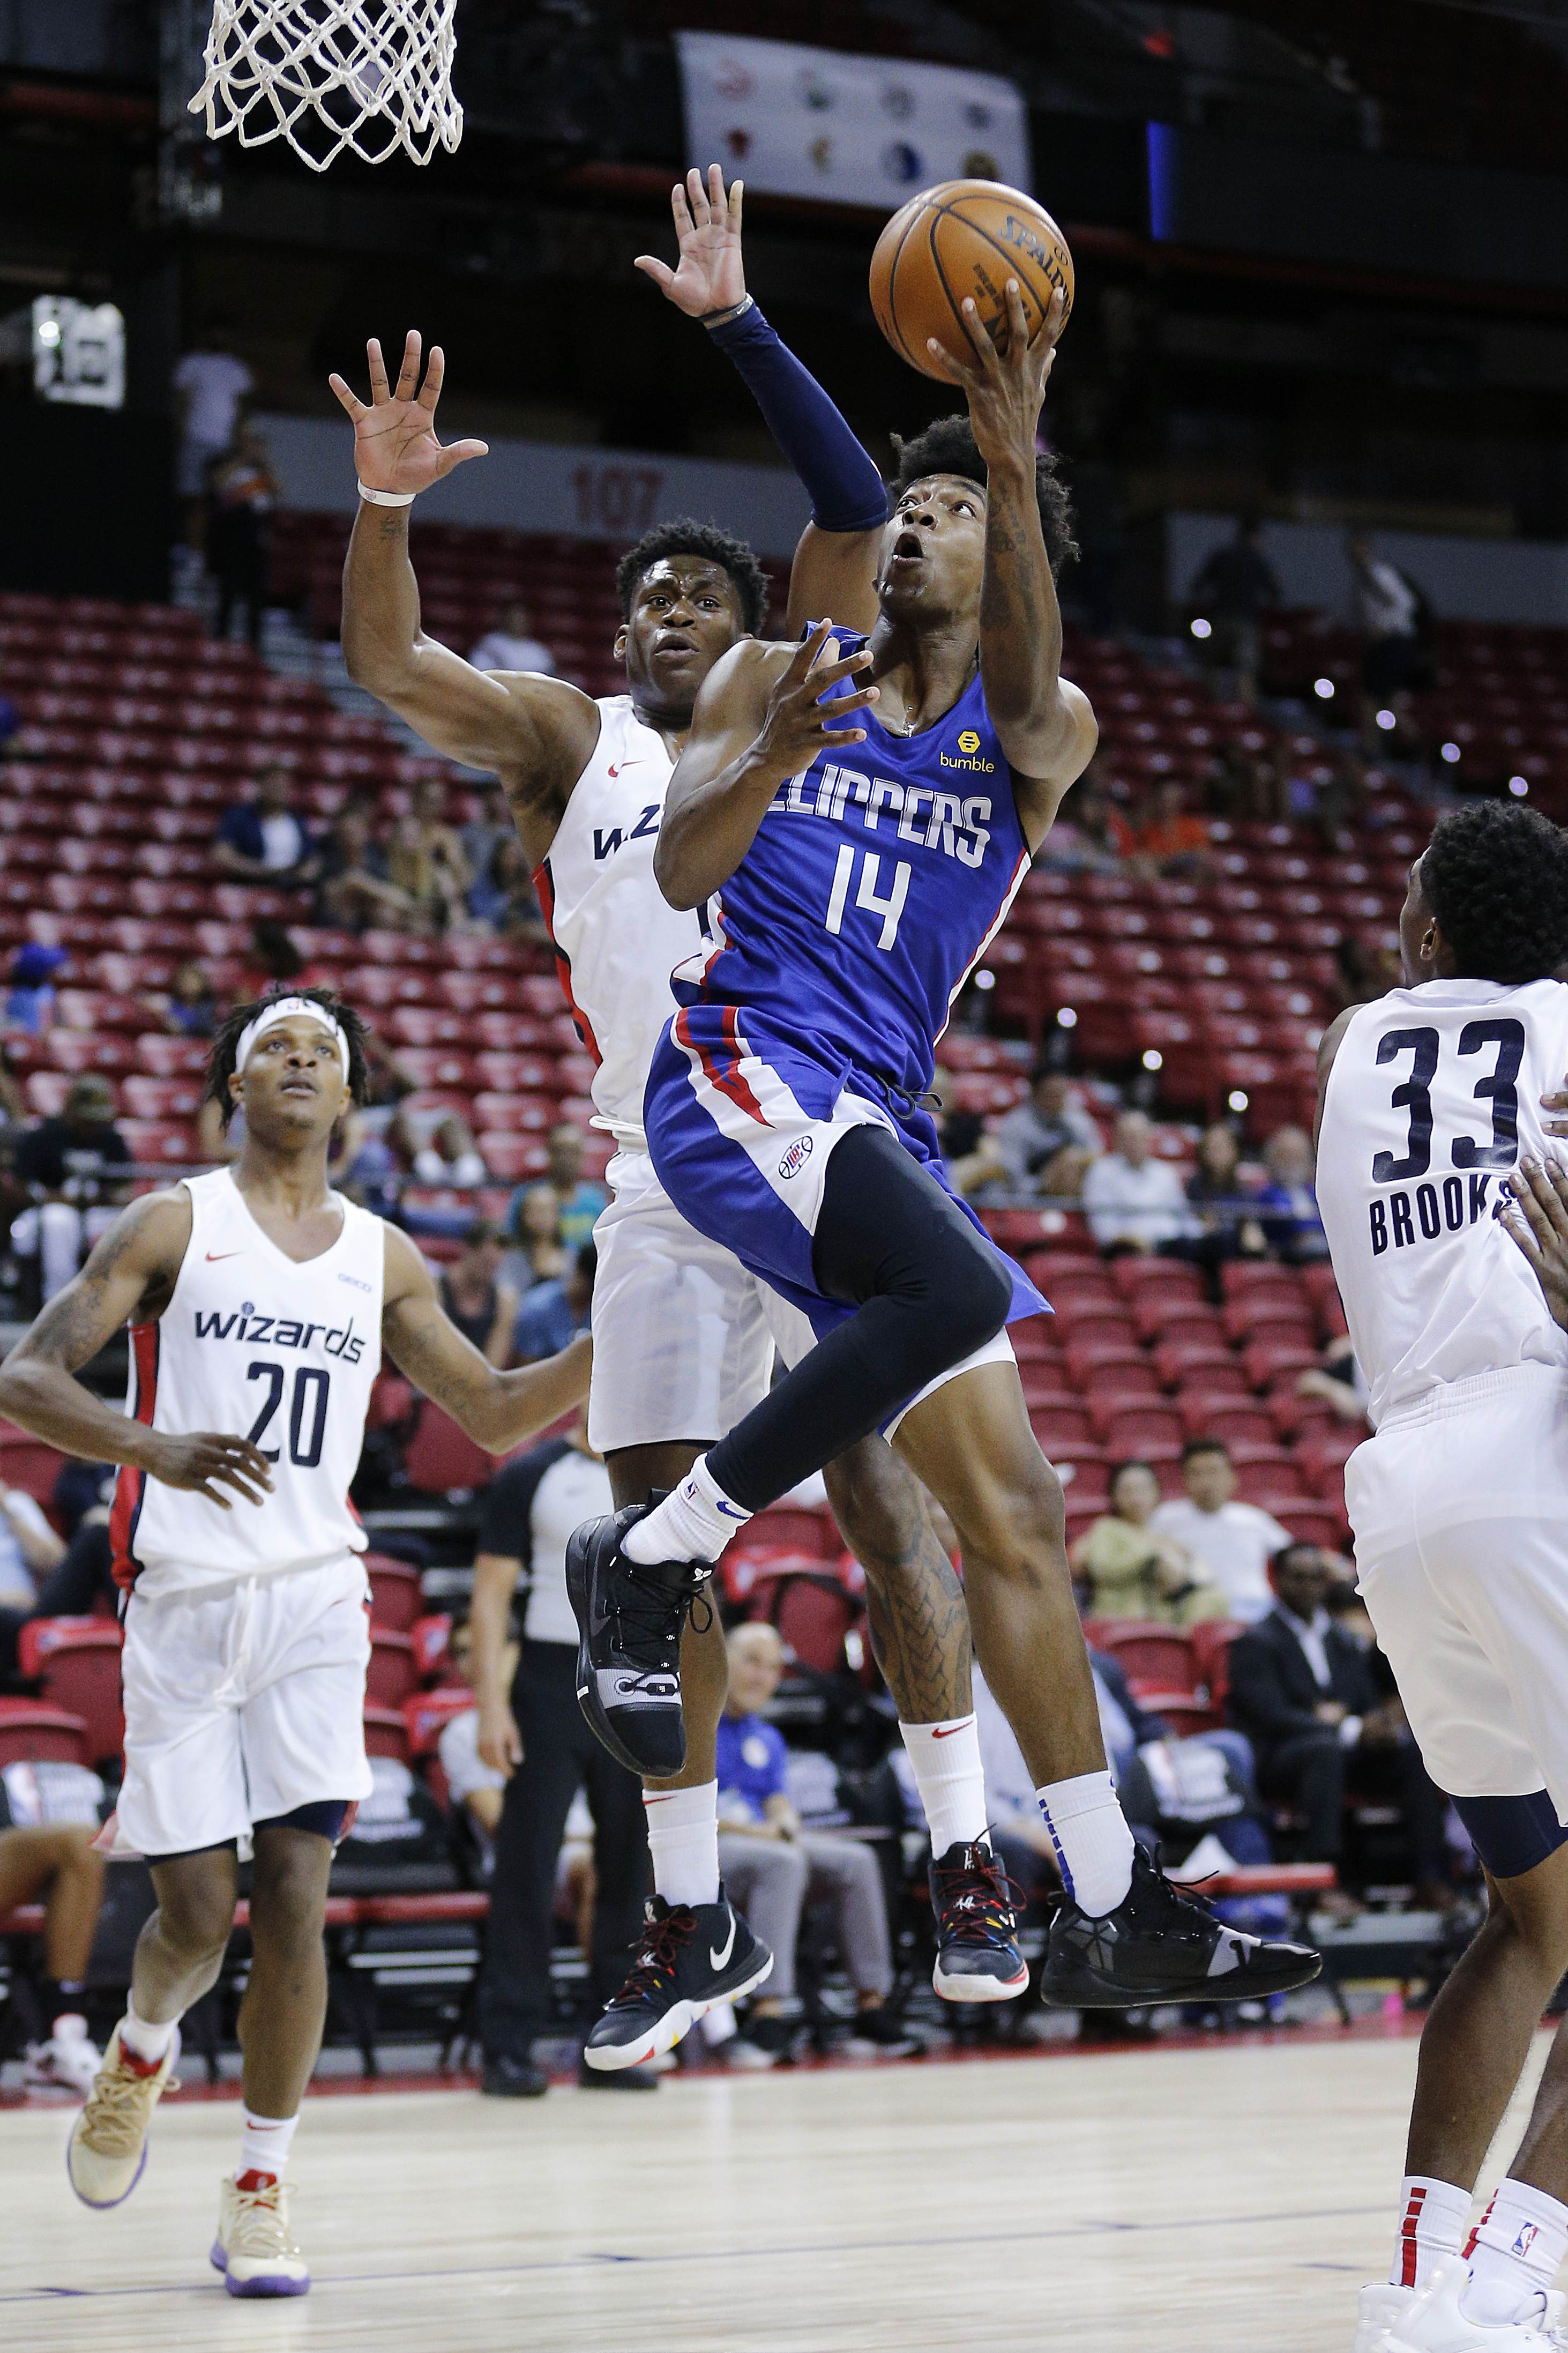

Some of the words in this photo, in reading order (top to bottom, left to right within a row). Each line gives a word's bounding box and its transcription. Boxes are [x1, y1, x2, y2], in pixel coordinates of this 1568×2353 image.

[571, 466, 662, 529] 107
[940, 751, 995, 773] bumble
[767, 763, 992, 868] LIPPERS
[825, 844, 912, 951] 14
[1372, 1018, 1525, 1183] 33
[247, 1361, 330, 1468] 20
